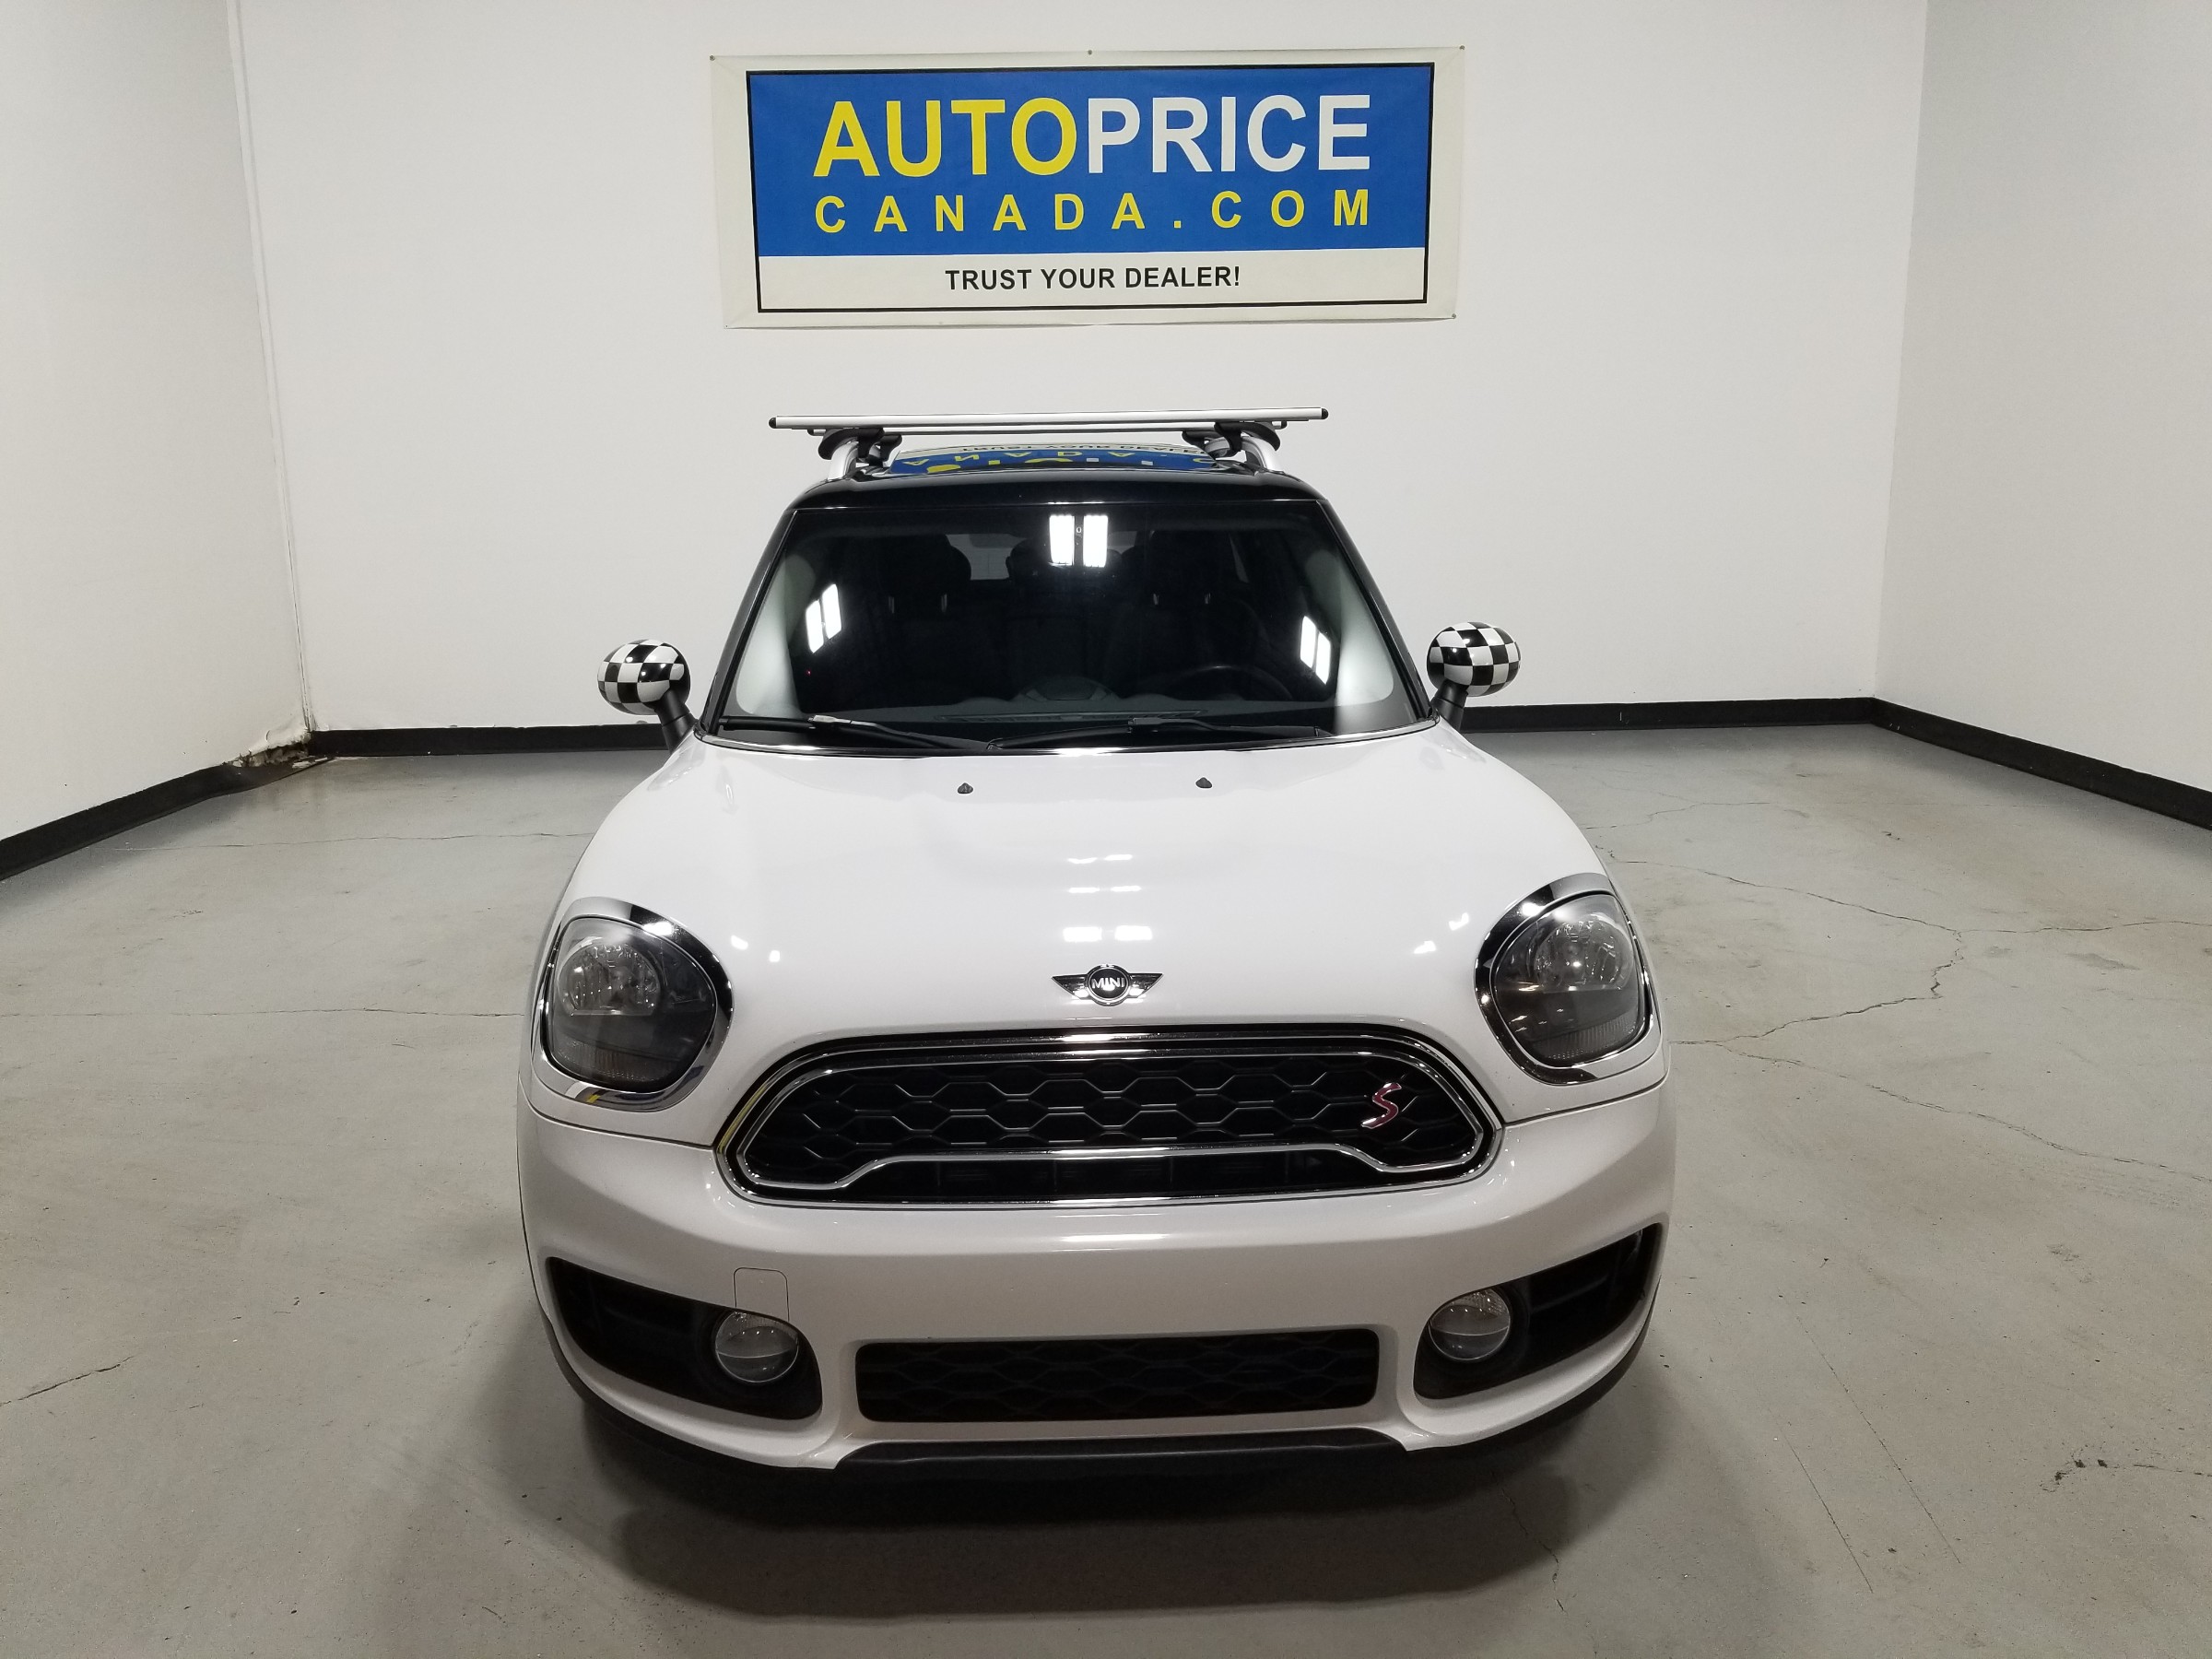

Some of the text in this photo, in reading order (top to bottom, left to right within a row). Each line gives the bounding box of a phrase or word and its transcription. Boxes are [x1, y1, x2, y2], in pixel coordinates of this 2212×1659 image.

[813, 94, 1371, 177] AUTOPRICE
[815, 188, 1369, 233] CANADA.COM
[945, 265, 1240, 290] TRUST YOUR DEALER!
[1091, 977, 1125, 989] MINI
[1360, 1082, 1402, 1129] S
